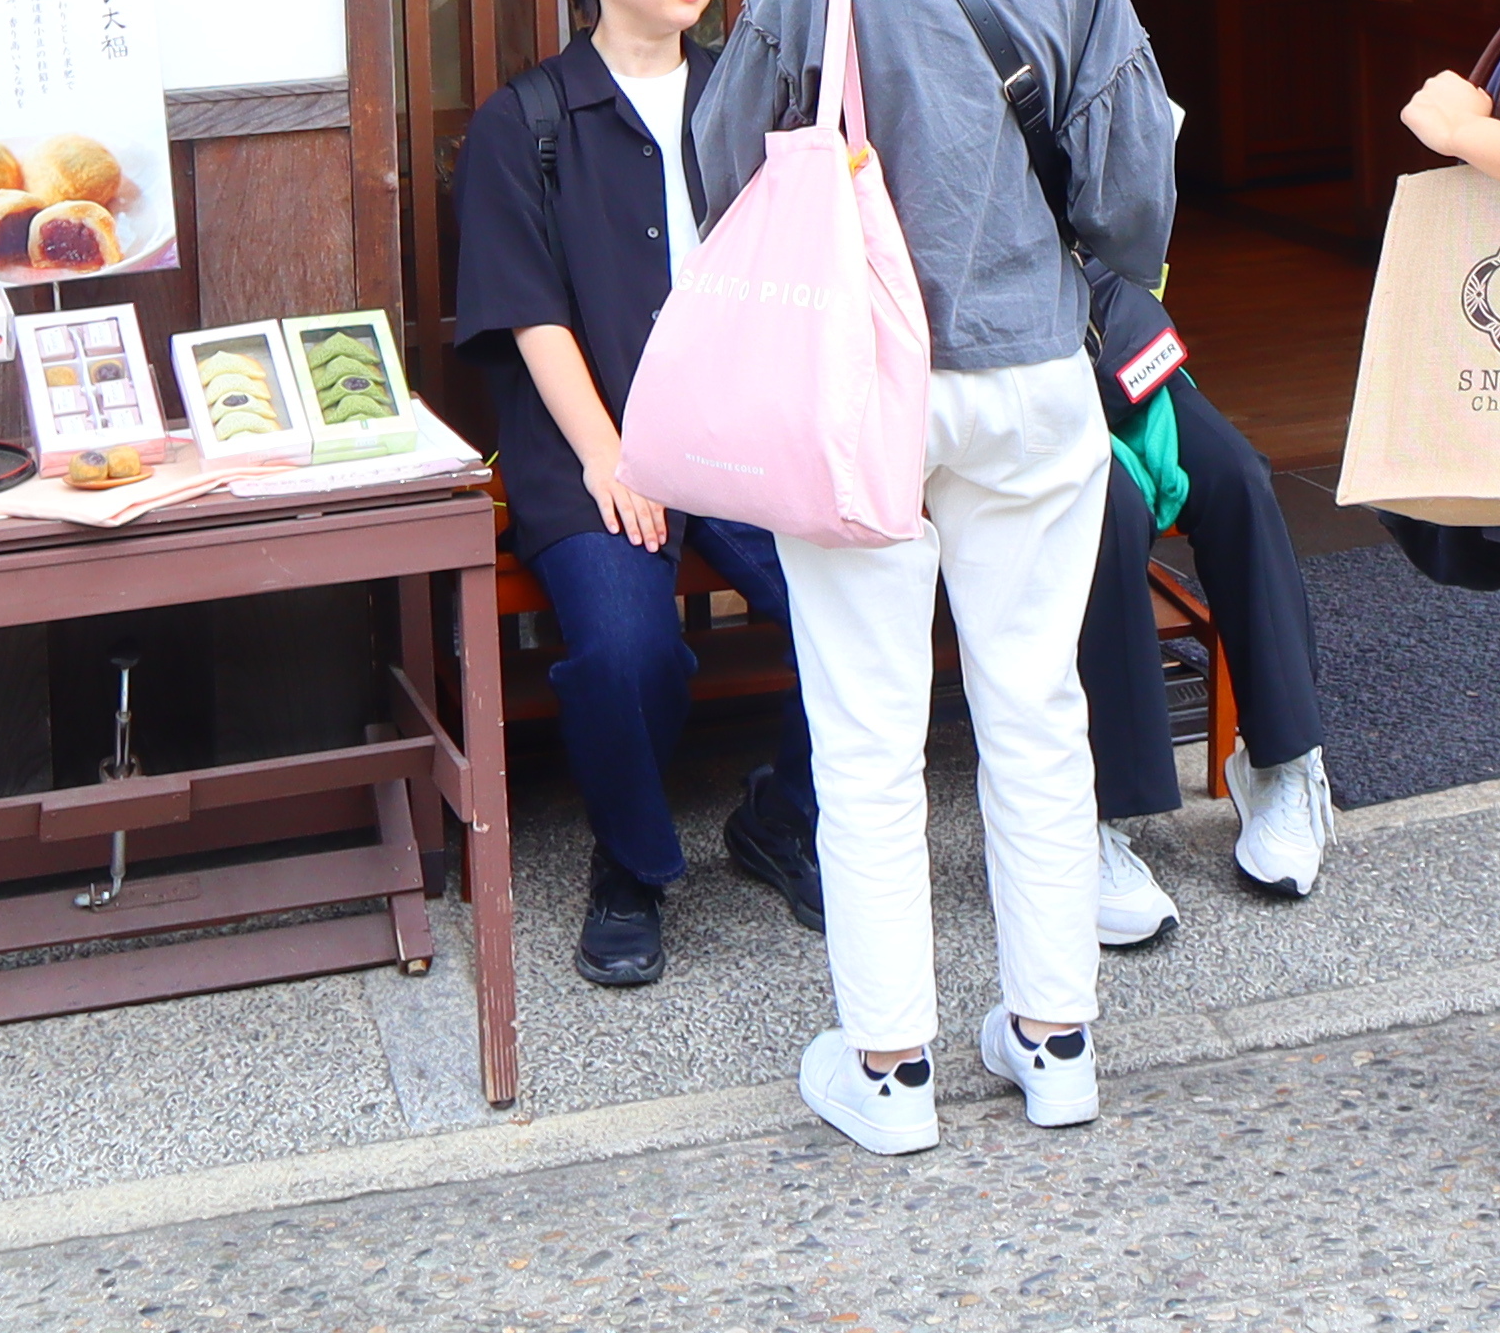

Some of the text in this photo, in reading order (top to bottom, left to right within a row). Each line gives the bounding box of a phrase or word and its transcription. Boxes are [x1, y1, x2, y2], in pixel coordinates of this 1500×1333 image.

[675, 269, 750, 301] GELATO
[1128, 343, 1177, 389] HUNTER
[735, 464, 765, 475] COLOR
